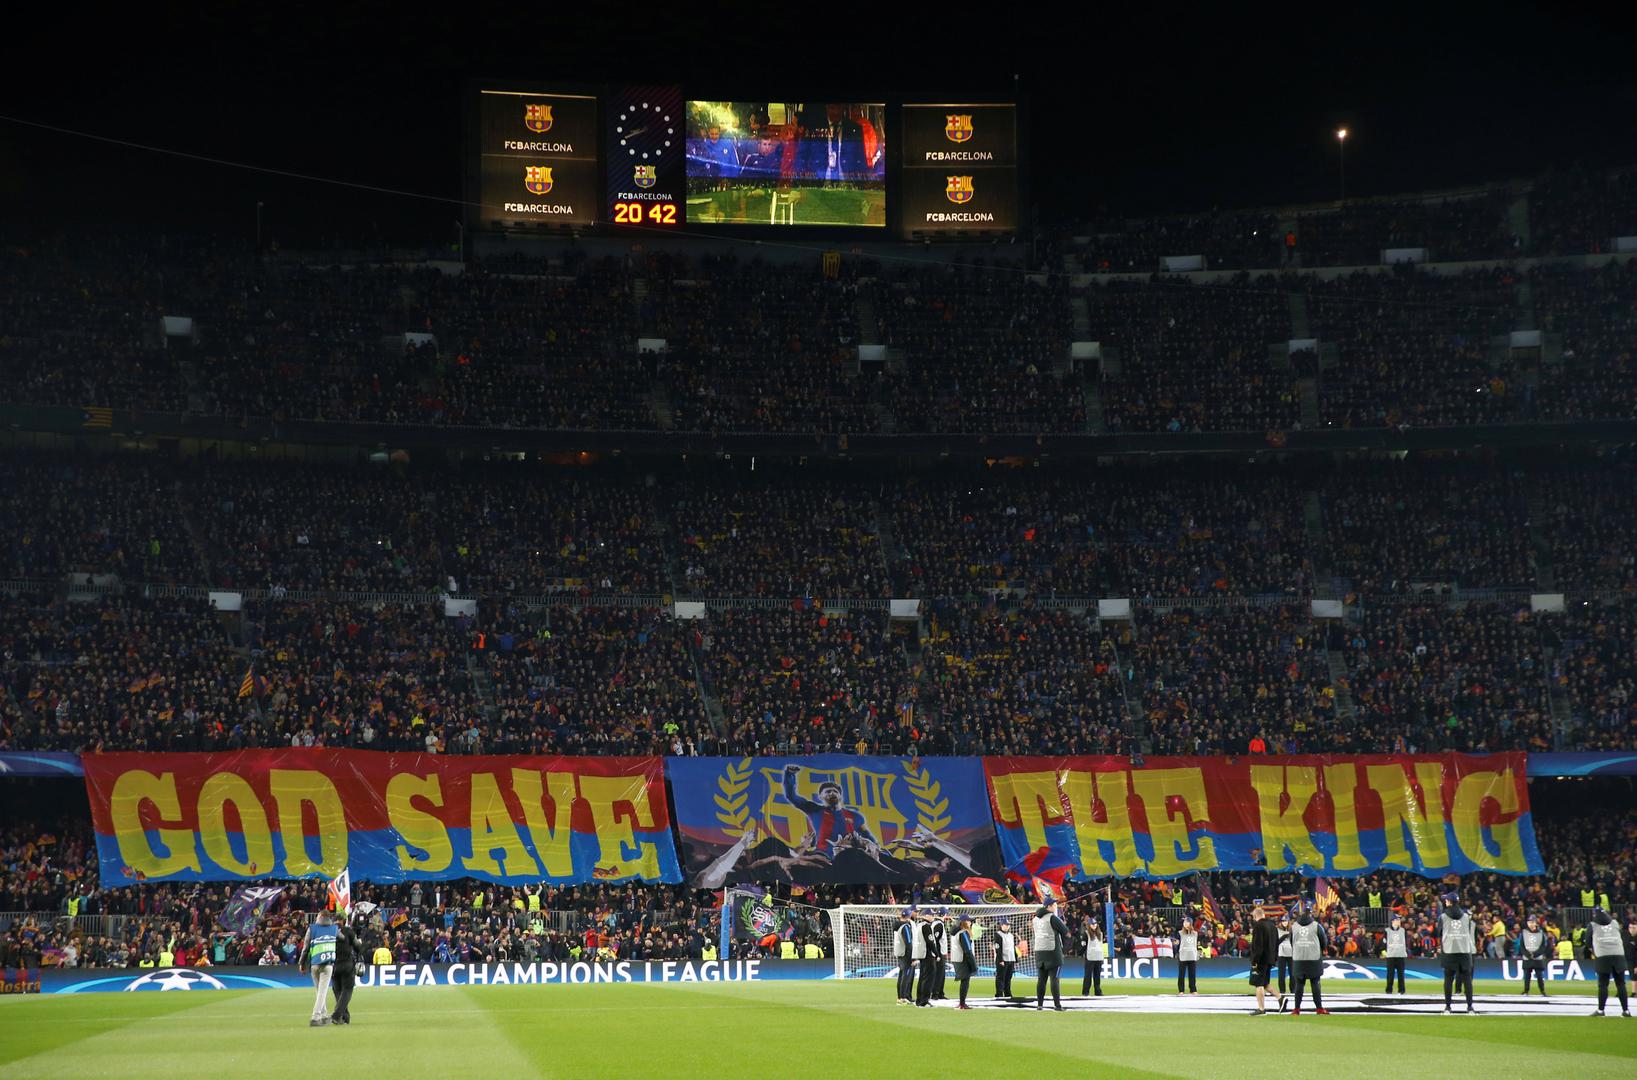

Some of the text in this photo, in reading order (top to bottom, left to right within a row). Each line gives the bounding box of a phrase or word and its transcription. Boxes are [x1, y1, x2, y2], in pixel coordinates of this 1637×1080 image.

[614, 203, 676, 223] 20 42
[111, 768, 661, 881] GOD SAVE
[991, 762, 1530, 877] THE KING
[354, 964, 436, 986] UEFA
[447, 961, 632, 985] CHAMPIONS
